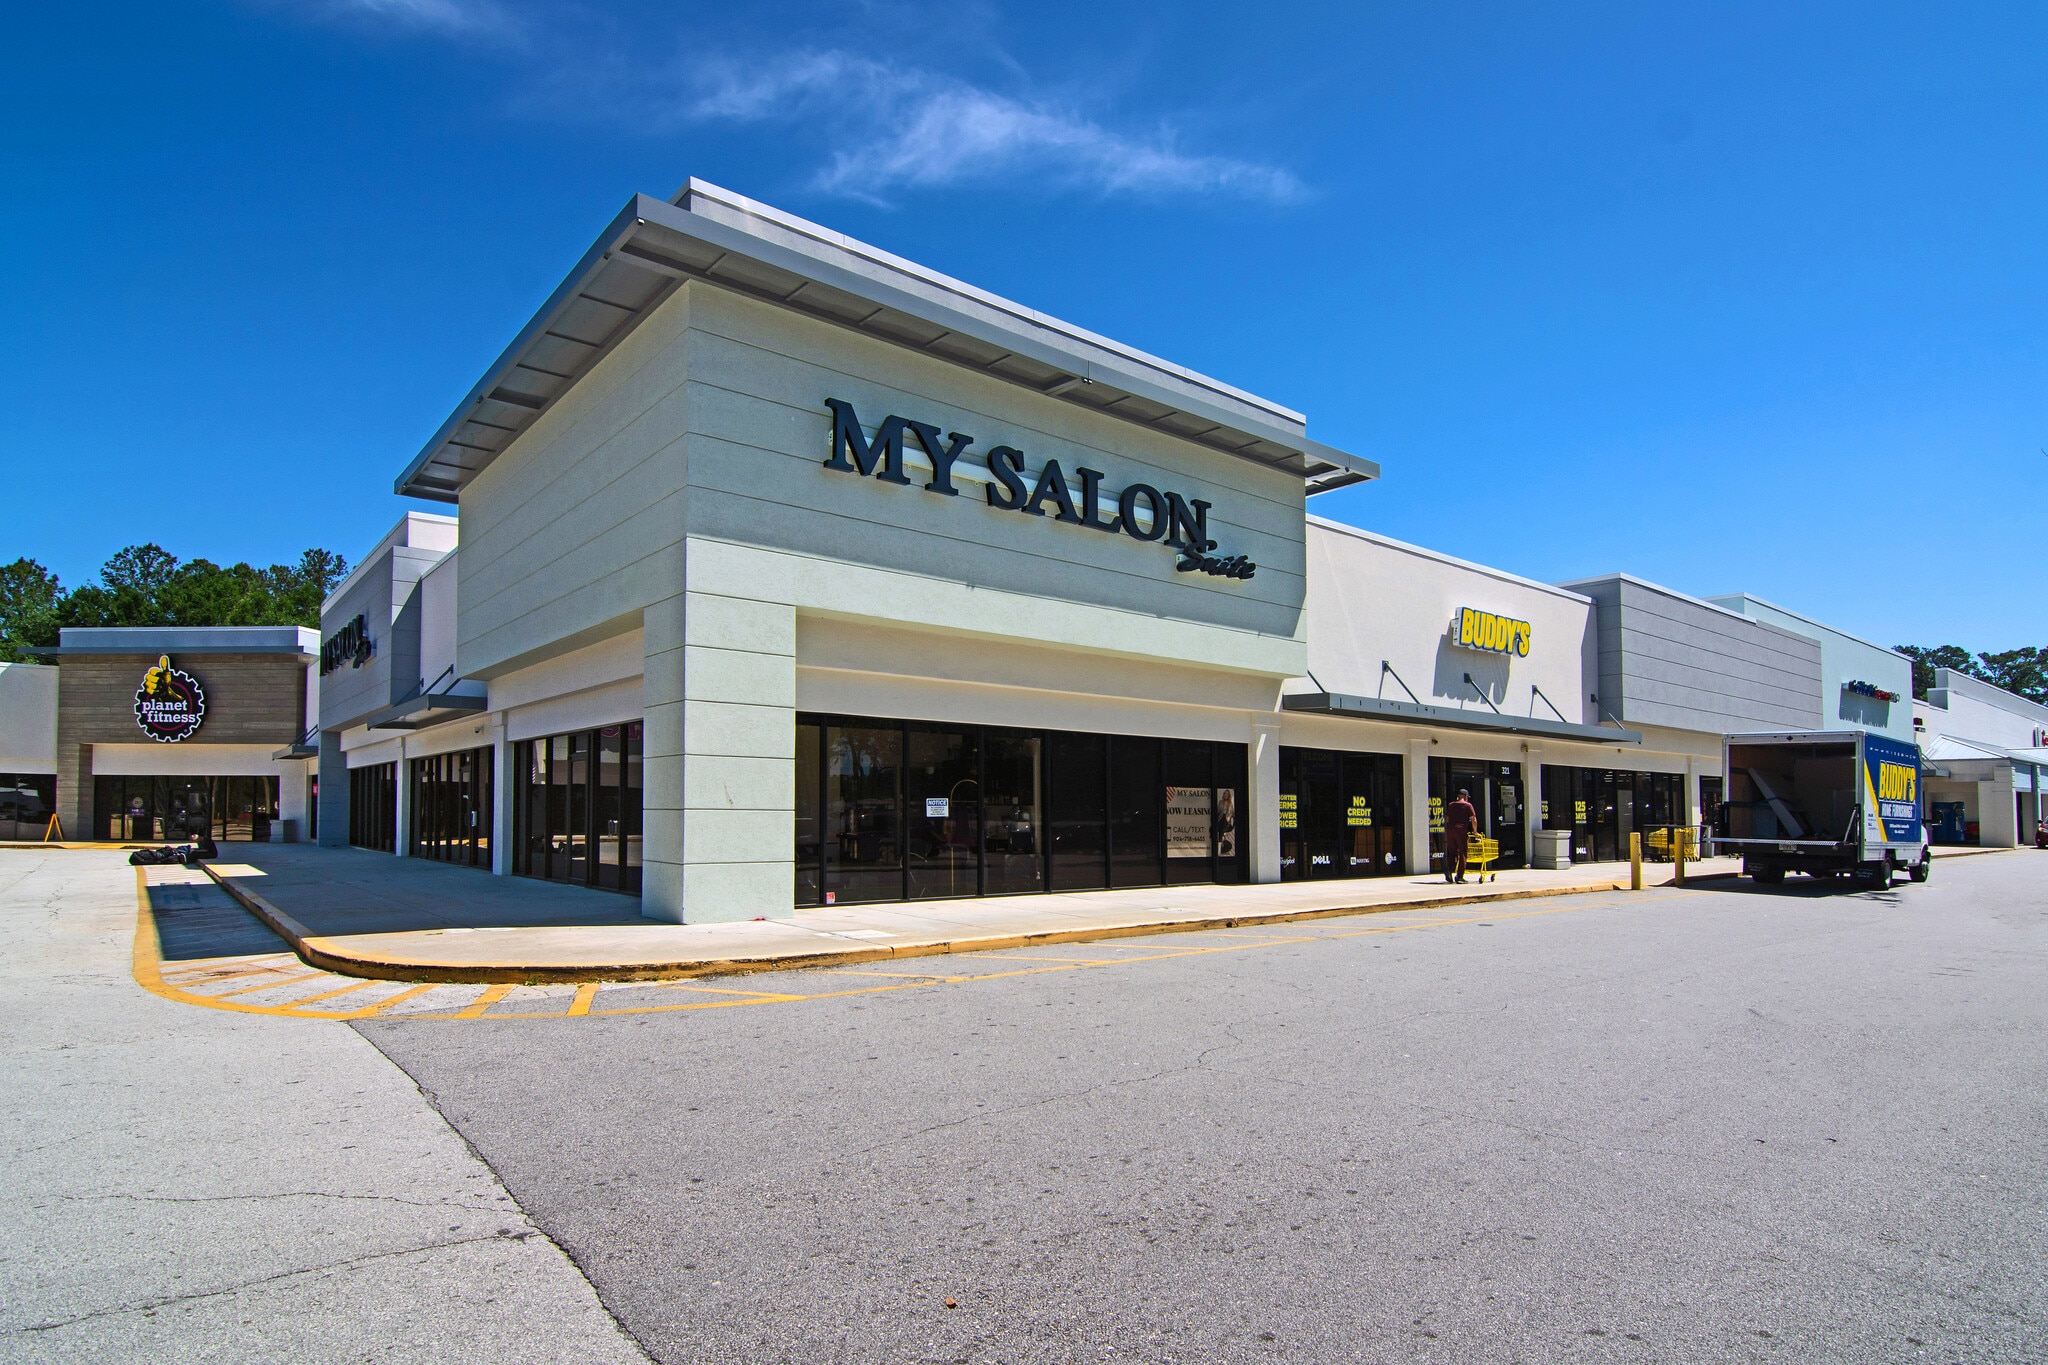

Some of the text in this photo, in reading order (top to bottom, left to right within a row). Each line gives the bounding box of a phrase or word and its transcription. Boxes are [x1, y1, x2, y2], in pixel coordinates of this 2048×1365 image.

[823, 397, 1212, 553] MY SALON
[1176, 540, 1257, 580] Suite
[1459, 606, 1531, 658] BUDDY'S
[141, 699, 188, 714] planet
[146, 711, 196, 723] fitness
[1501, 767, 1510, 775] 321
[1878, 760, 1917, 804] BUDDY'S
[1279, 802, 1297, 810] ERMS
[1352, 796, 1366, 807] NO
[1347, 808, 1372, 817] CREDIT
[1279, 820, 1297, 828] RICES
[1347, 818, 1372, 826] NEEDED
[1312, 855, 1331, 865] DELL
